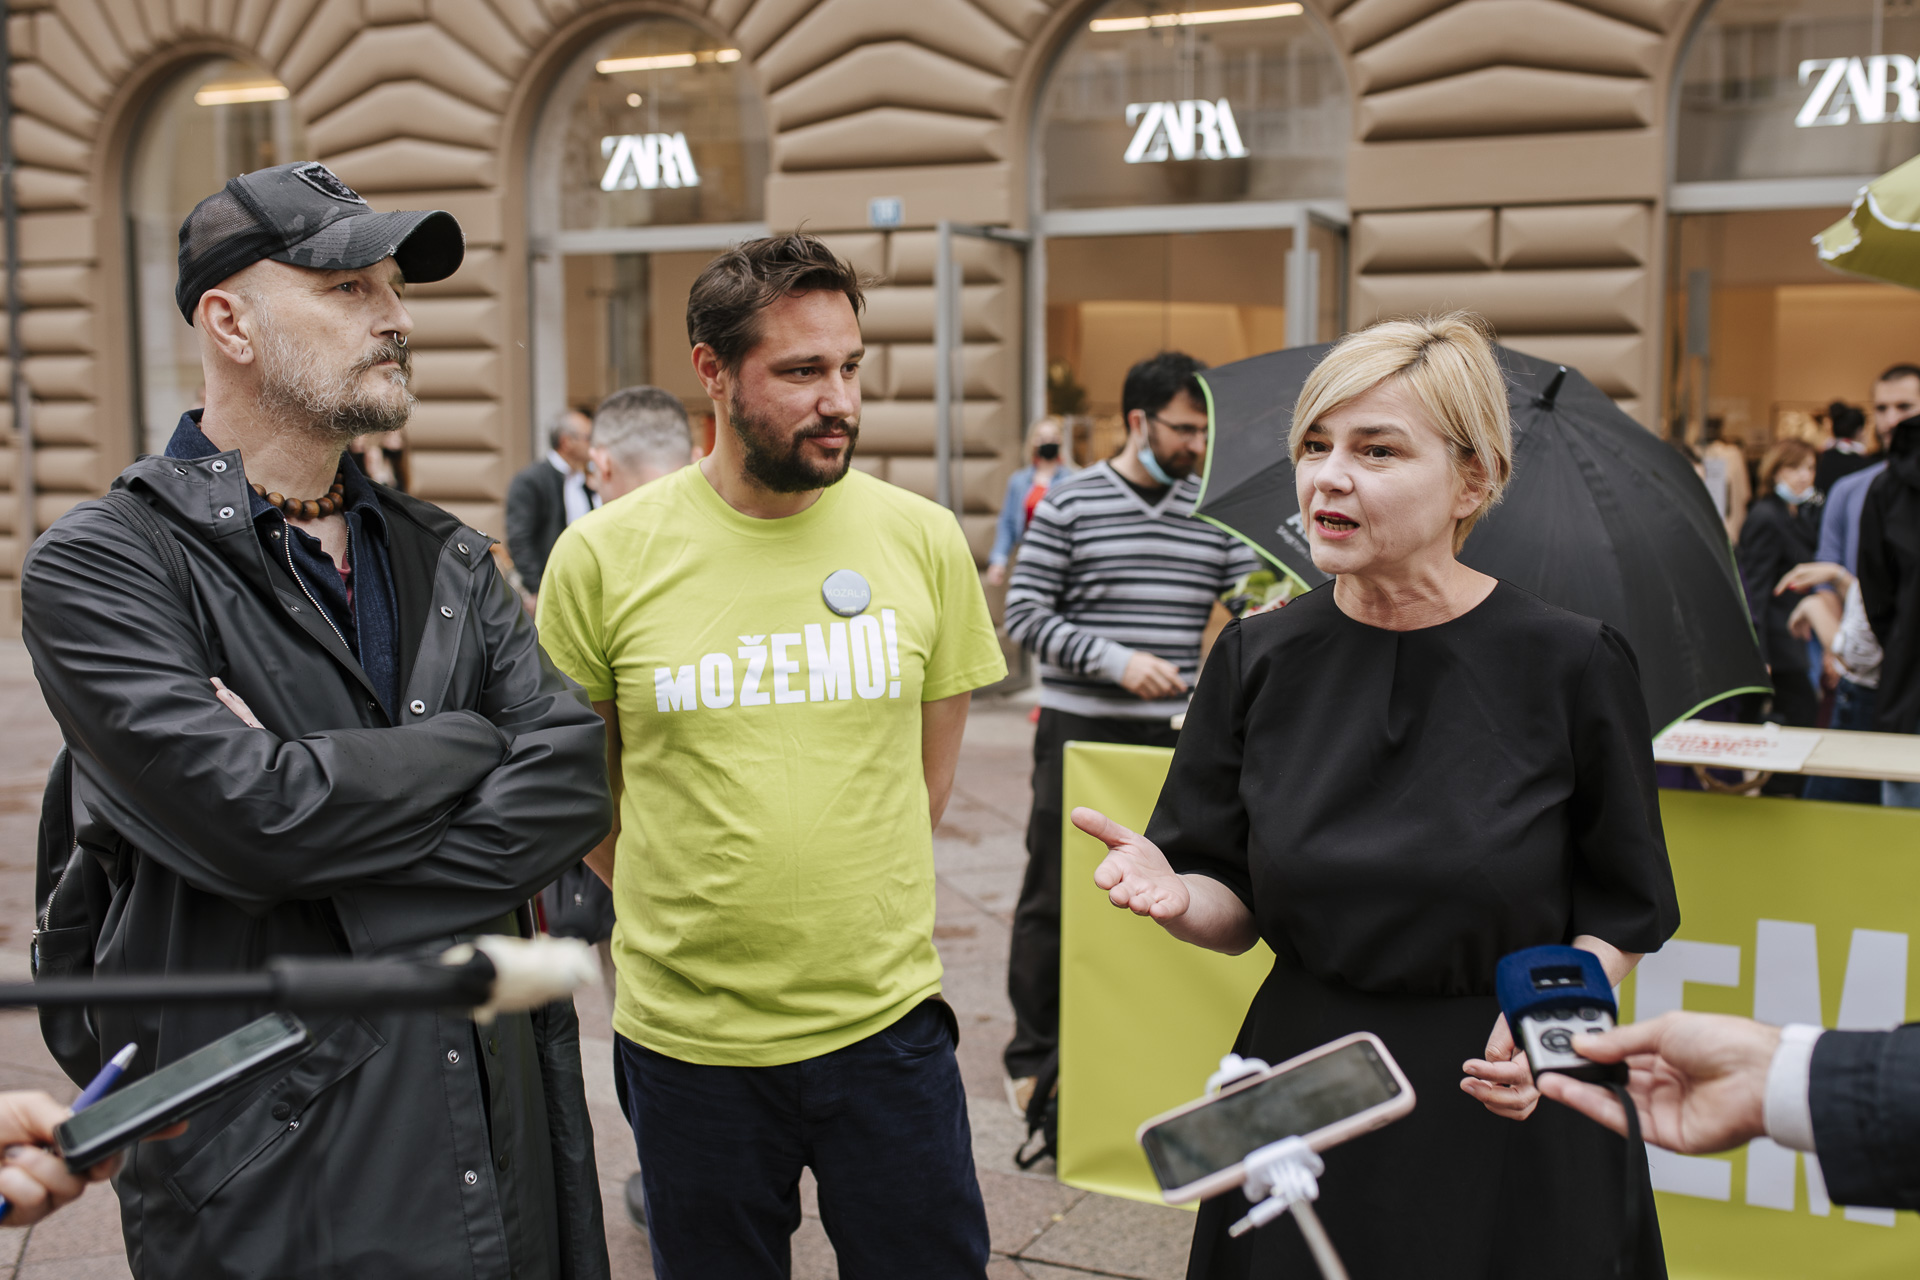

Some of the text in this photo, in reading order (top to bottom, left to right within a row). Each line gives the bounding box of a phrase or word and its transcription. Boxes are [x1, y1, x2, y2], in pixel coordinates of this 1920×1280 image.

[1795, 54, 1920, 128] ZAR
[600, 131, 702, 192] ZARA
[1123, 97, 1250, 164] ZARA
[654, 608, 901, 712] MOŽEMO!
